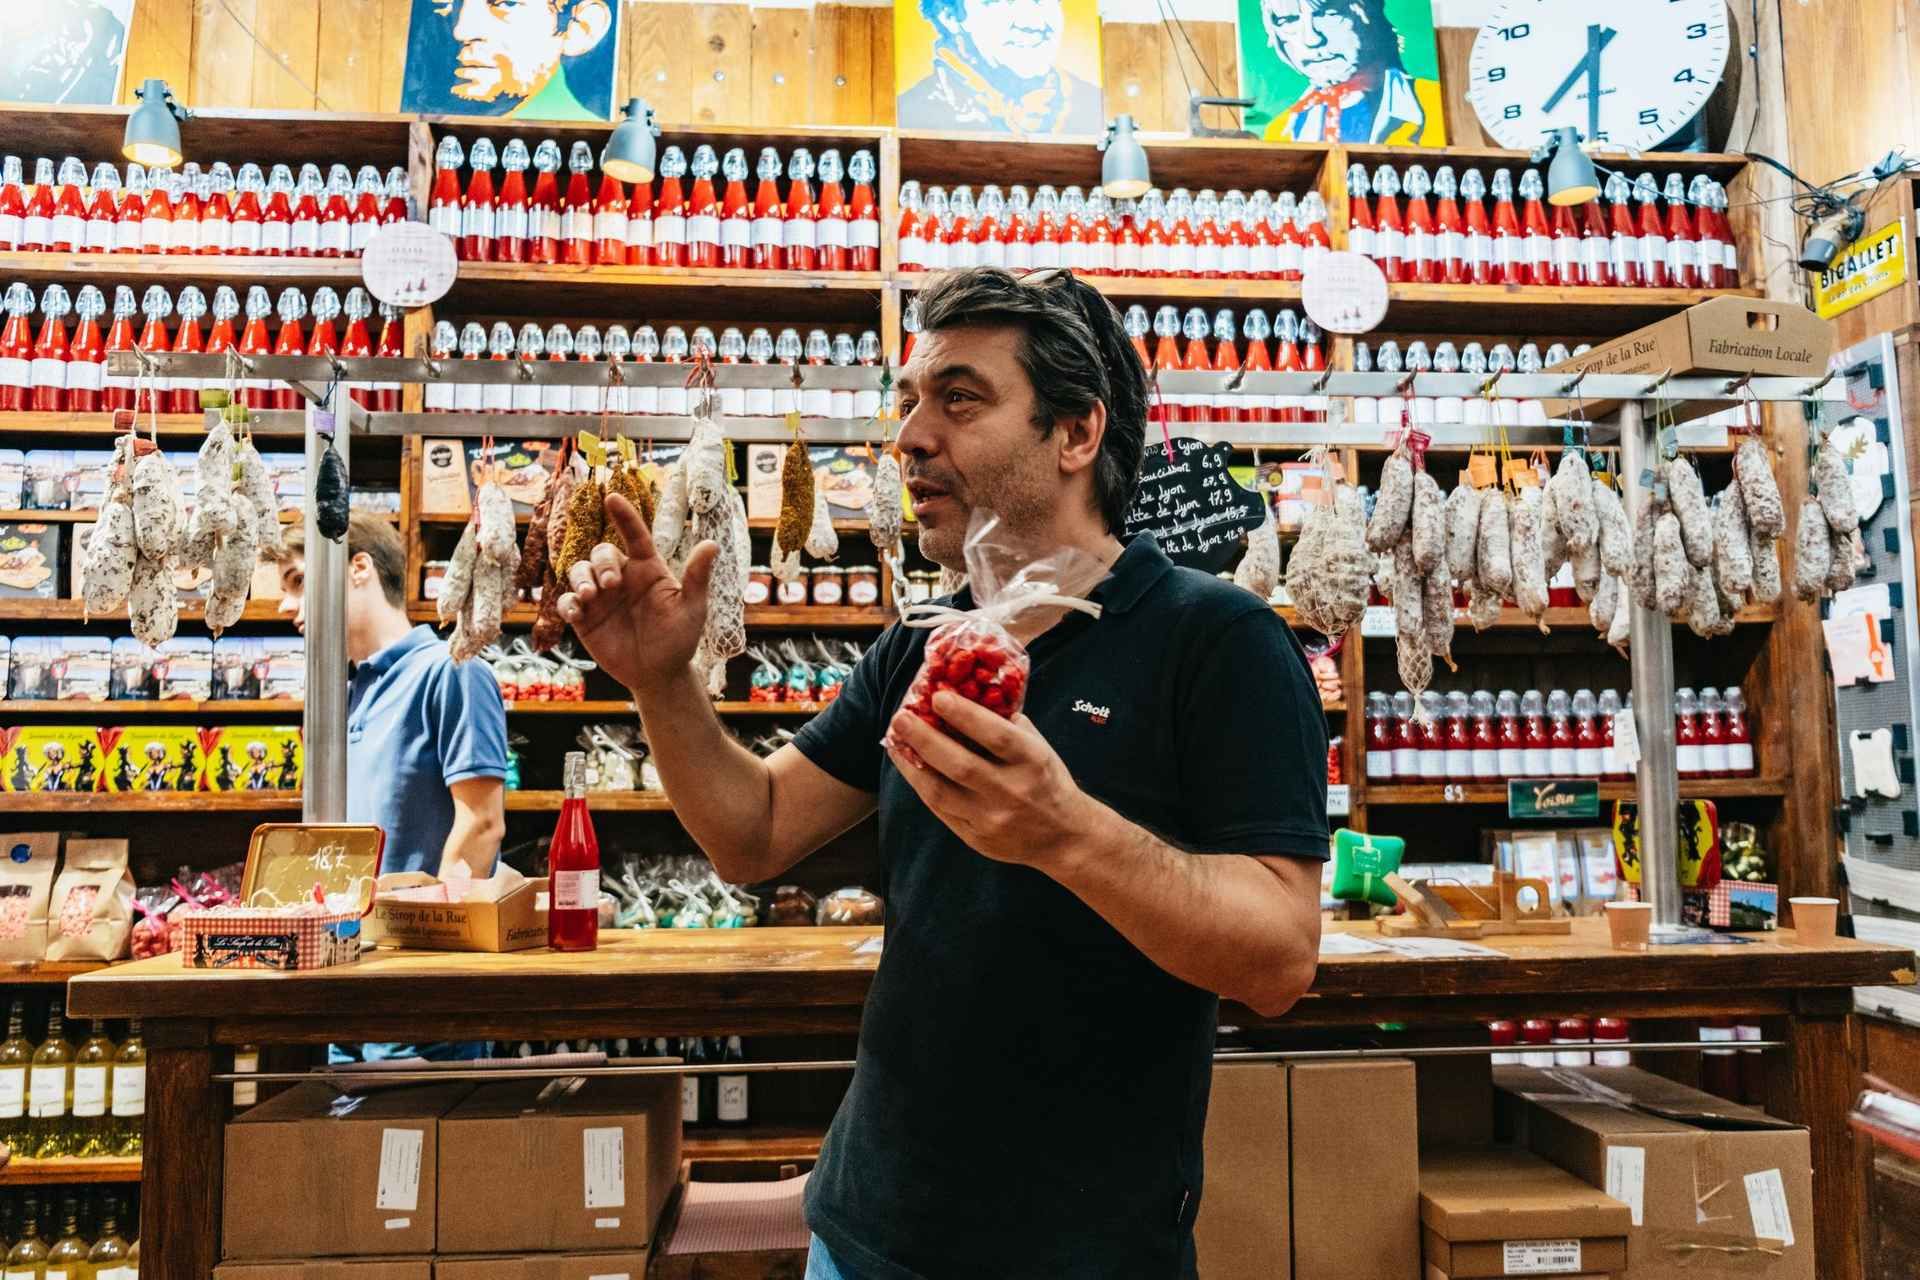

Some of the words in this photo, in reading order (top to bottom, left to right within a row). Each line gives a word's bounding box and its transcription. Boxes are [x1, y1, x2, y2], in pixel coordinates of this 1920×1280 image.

[1497, 24, 1530, 41] 10
[1686, 23, 1708, 40] 3
[1488, 67, 1507, 82] 9
[1673, 68, 1695, 83] 4
[1503, 104, 1522, 119] 8
[1639, 108, 1659, 125] 5
[1821, 234, 1895, 289] BIGALLET
[1605, 351, 1618, 367] de
[1620, 347, 1632, 361] la
[1633, 340, 1656, 357] Rue
[1708, 339, 1773, 359] Fabrication
[1775, 346, 1814, 363] Locale
[1177, 440, 1204, 455] Lyon
[1071, 699, 1111, 718] Schott
